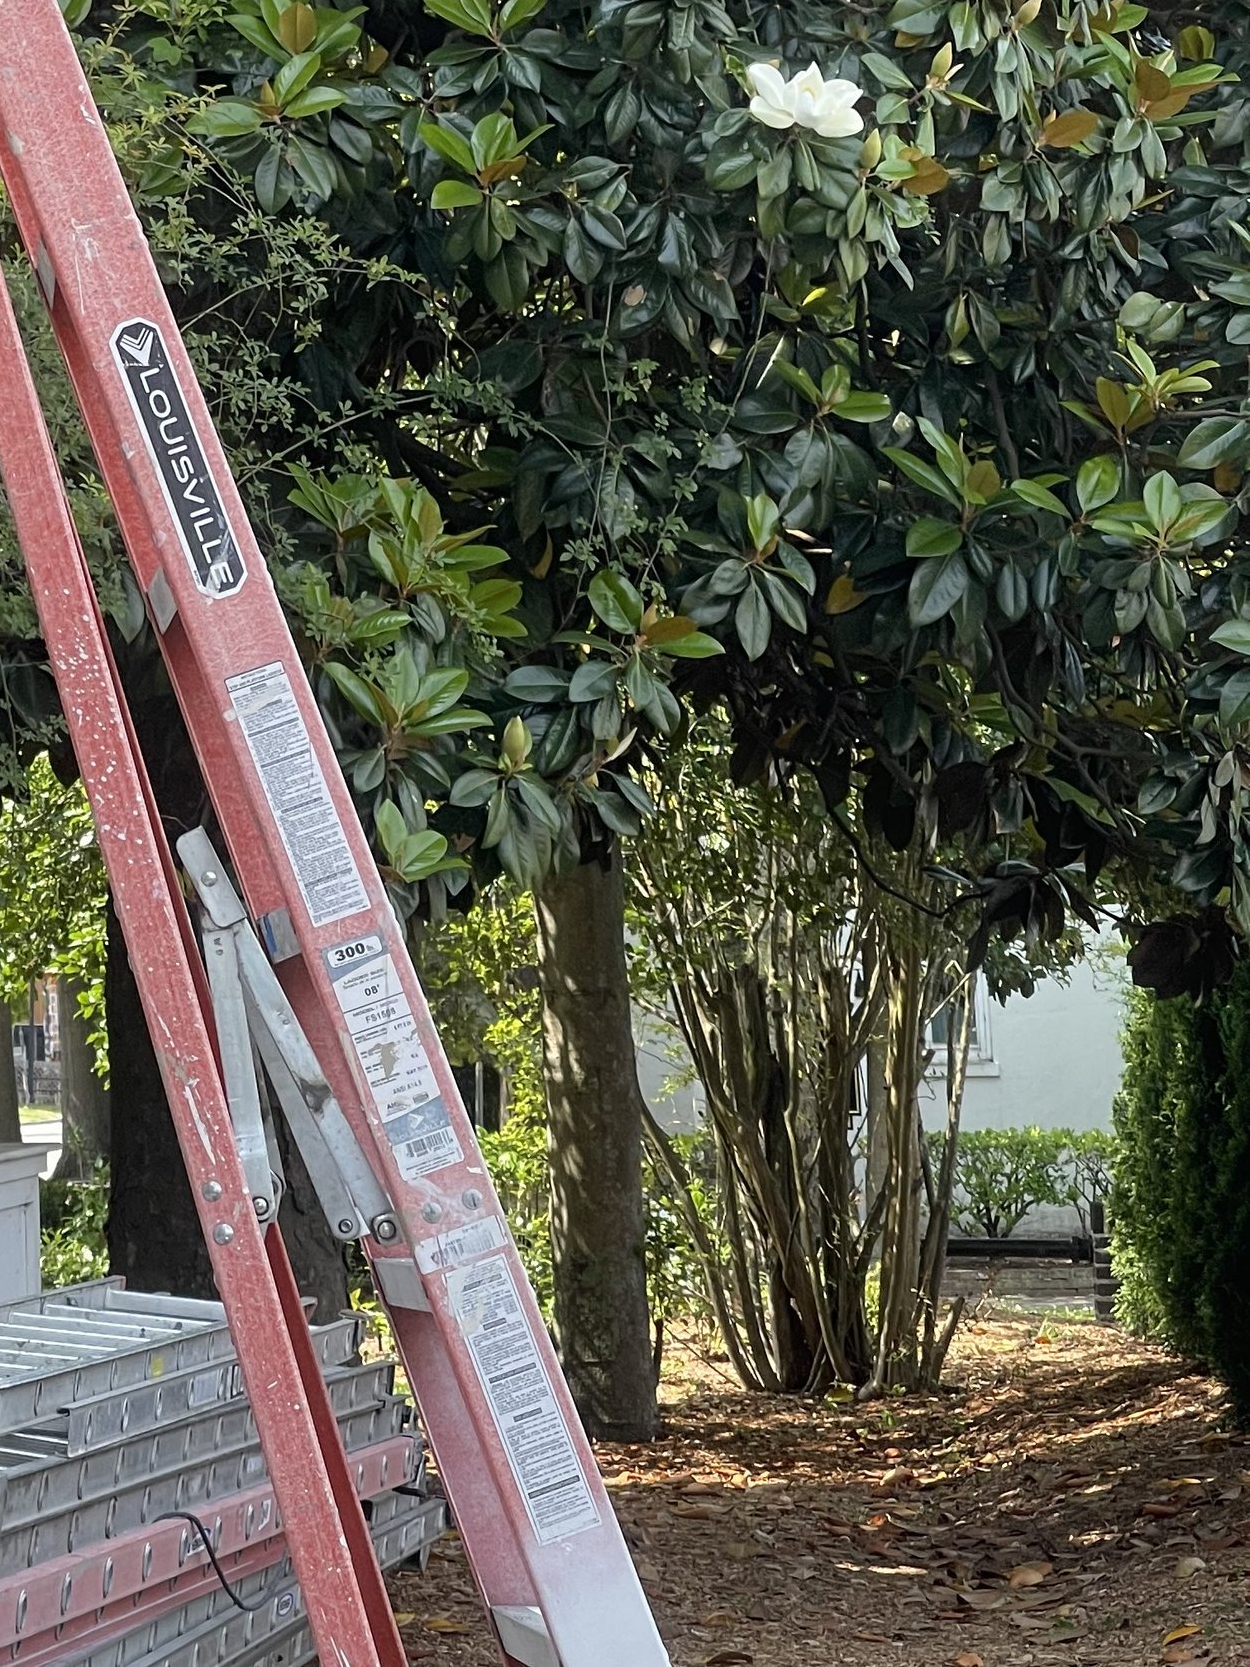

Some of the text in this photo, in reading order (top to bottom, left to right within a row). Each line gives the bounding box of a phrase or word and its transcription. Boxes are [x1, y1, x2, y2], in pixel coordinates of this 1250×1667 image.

[140, 367, 235, 589] LOUISVILLE
[335, 942, 366, 962] 300
[364, 984, 380, 996] 08'
